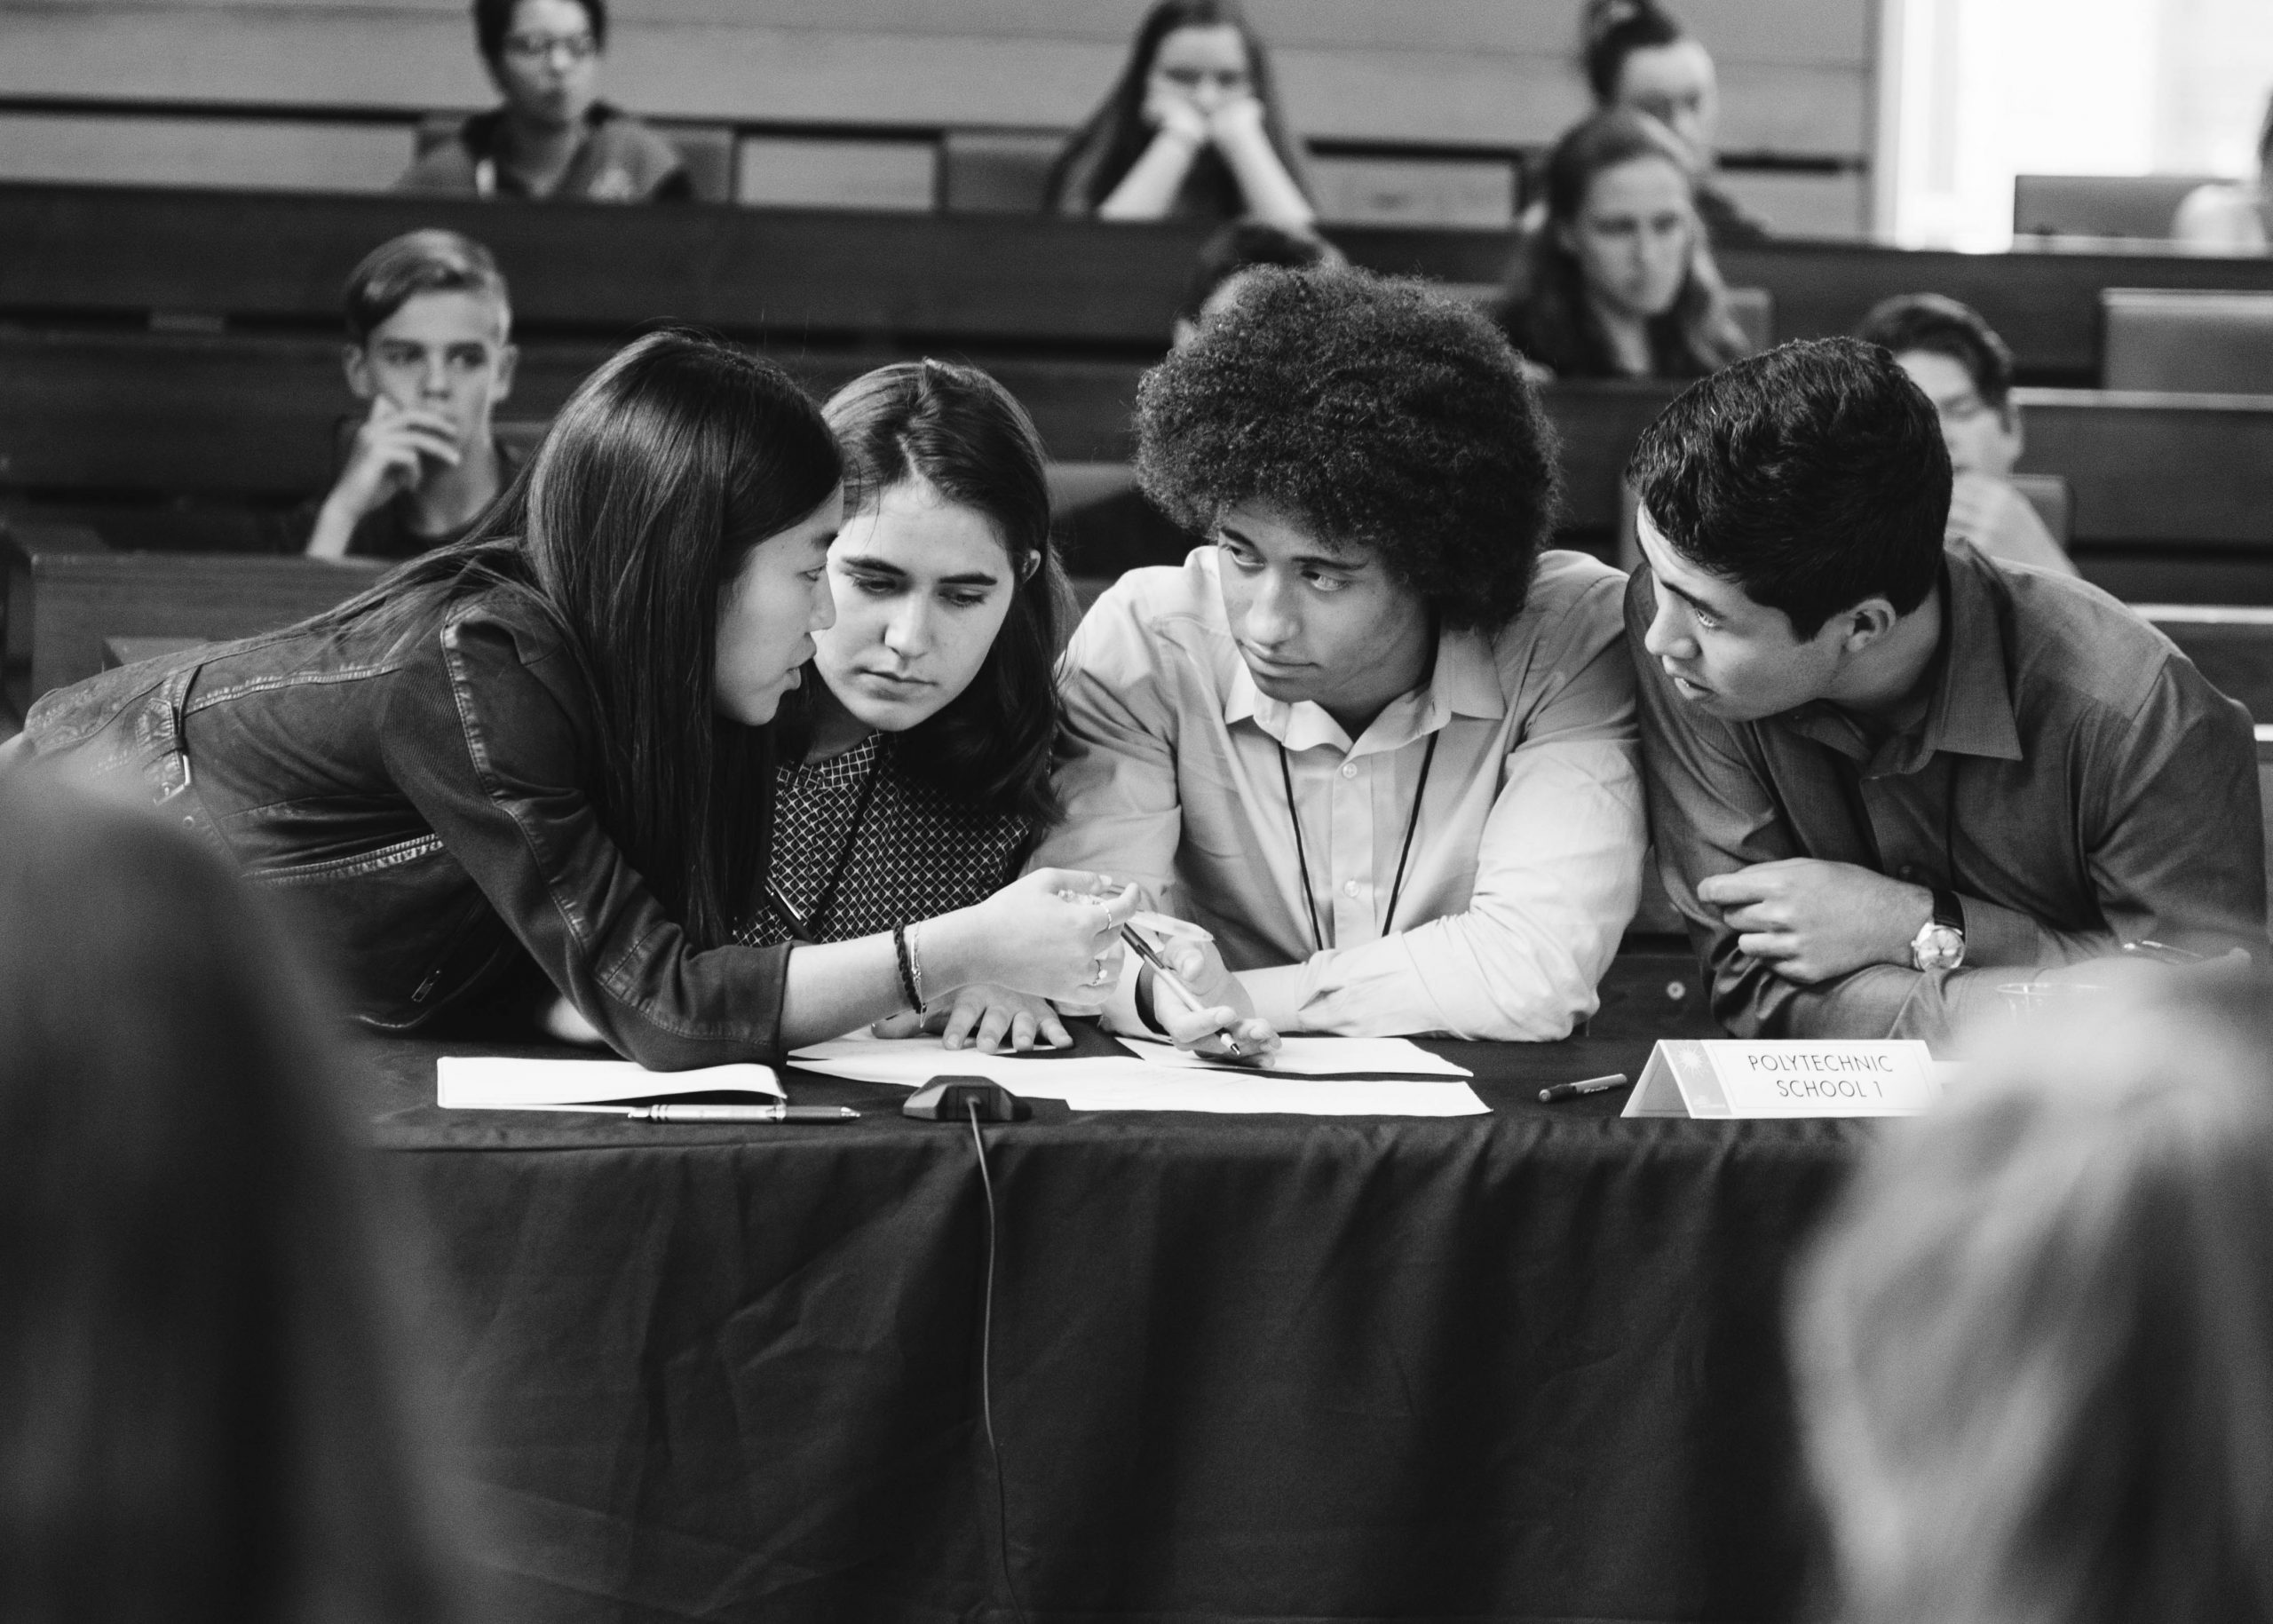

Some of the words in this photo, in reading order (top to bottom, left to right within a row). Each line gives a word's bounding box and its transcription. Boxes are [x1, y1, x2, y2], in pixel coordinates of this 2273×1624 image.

[1747, 1054, 1893, 1073] POLYTECHNIC
[1777, 1080, 1867, 1098] SCHOOL
[1873, 1080, 1883, 1098] 1
